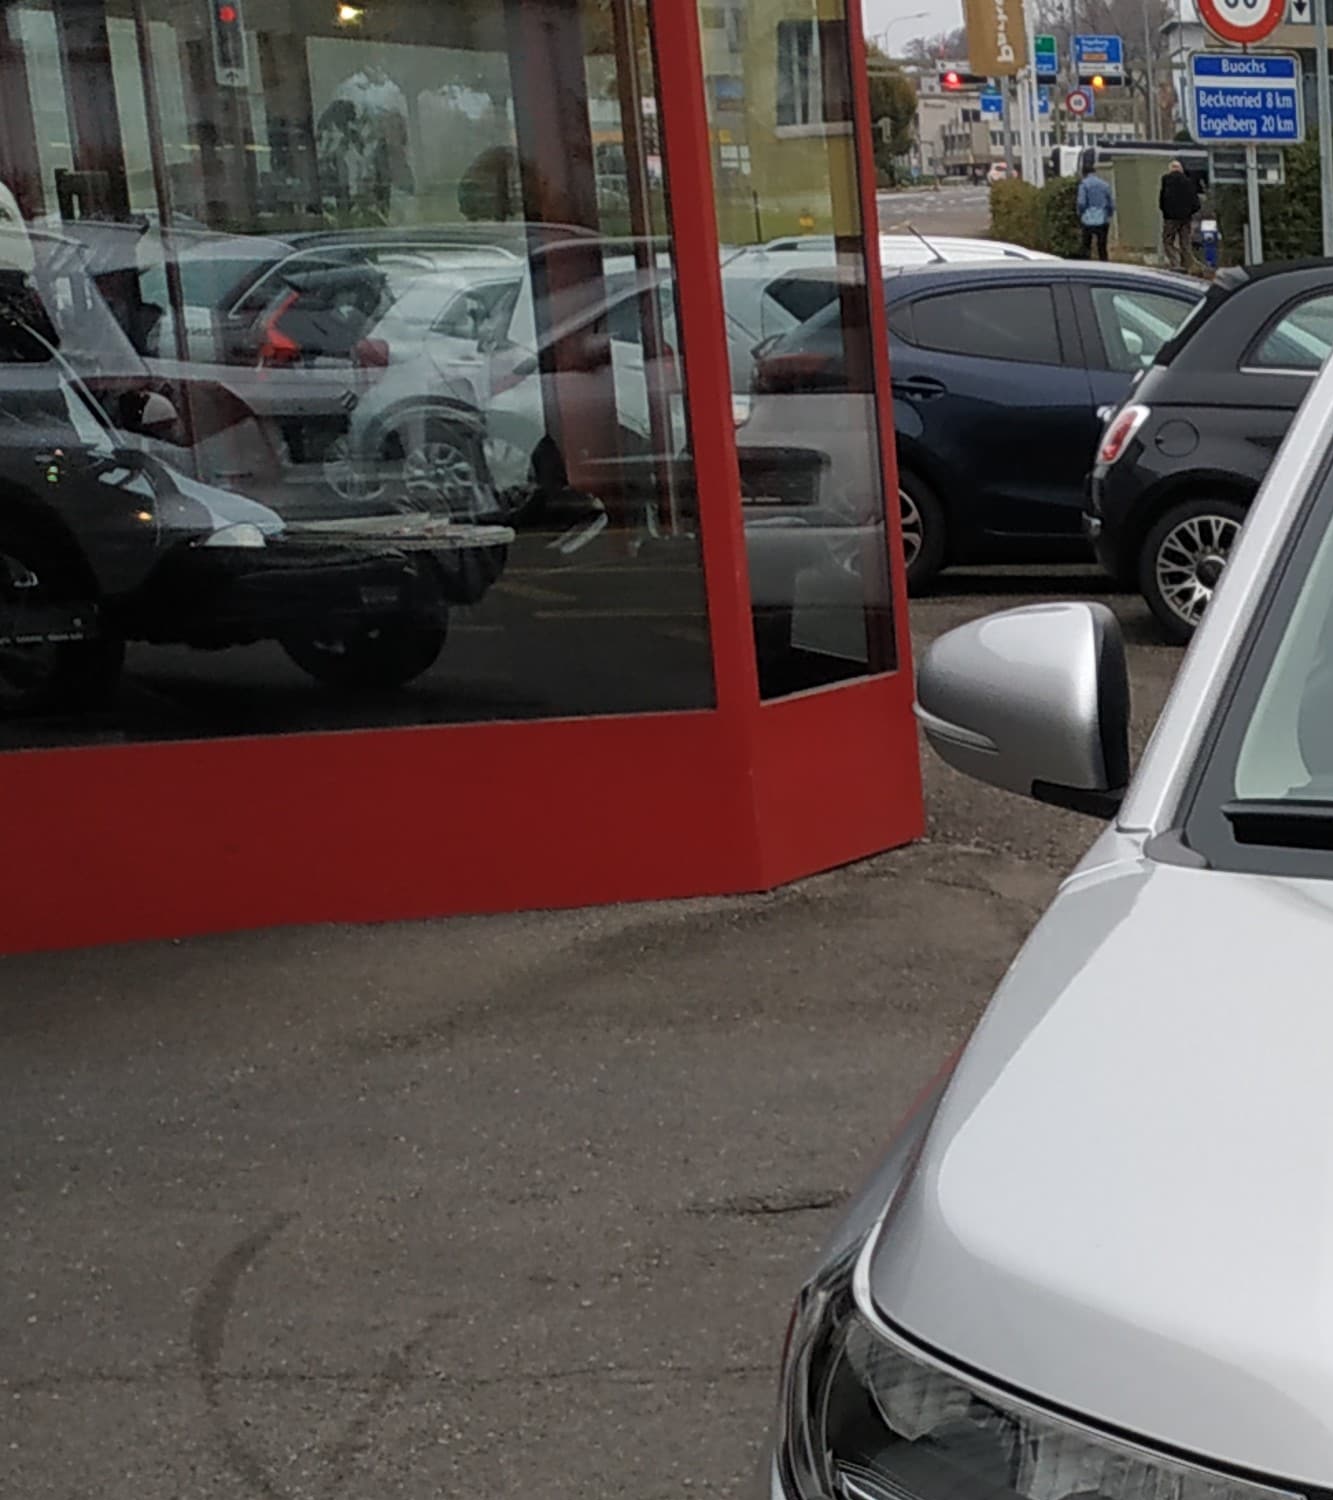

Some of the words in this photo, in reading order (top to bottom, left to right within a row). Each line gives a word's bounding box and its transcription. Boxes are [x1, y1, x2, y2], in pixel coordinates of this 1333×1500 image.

[1221, 58, 1267, 73] Buochs
[1199, 90, 1262, 108] Beckenried
[1265, 91, 1274, 108] 8
[1275, 91, 1293, 108] km
[1200, 113, 1258, 136] Engelberg
[1261, 115, 1275, 132] 20
[1277, 115, 1294, 132] km
